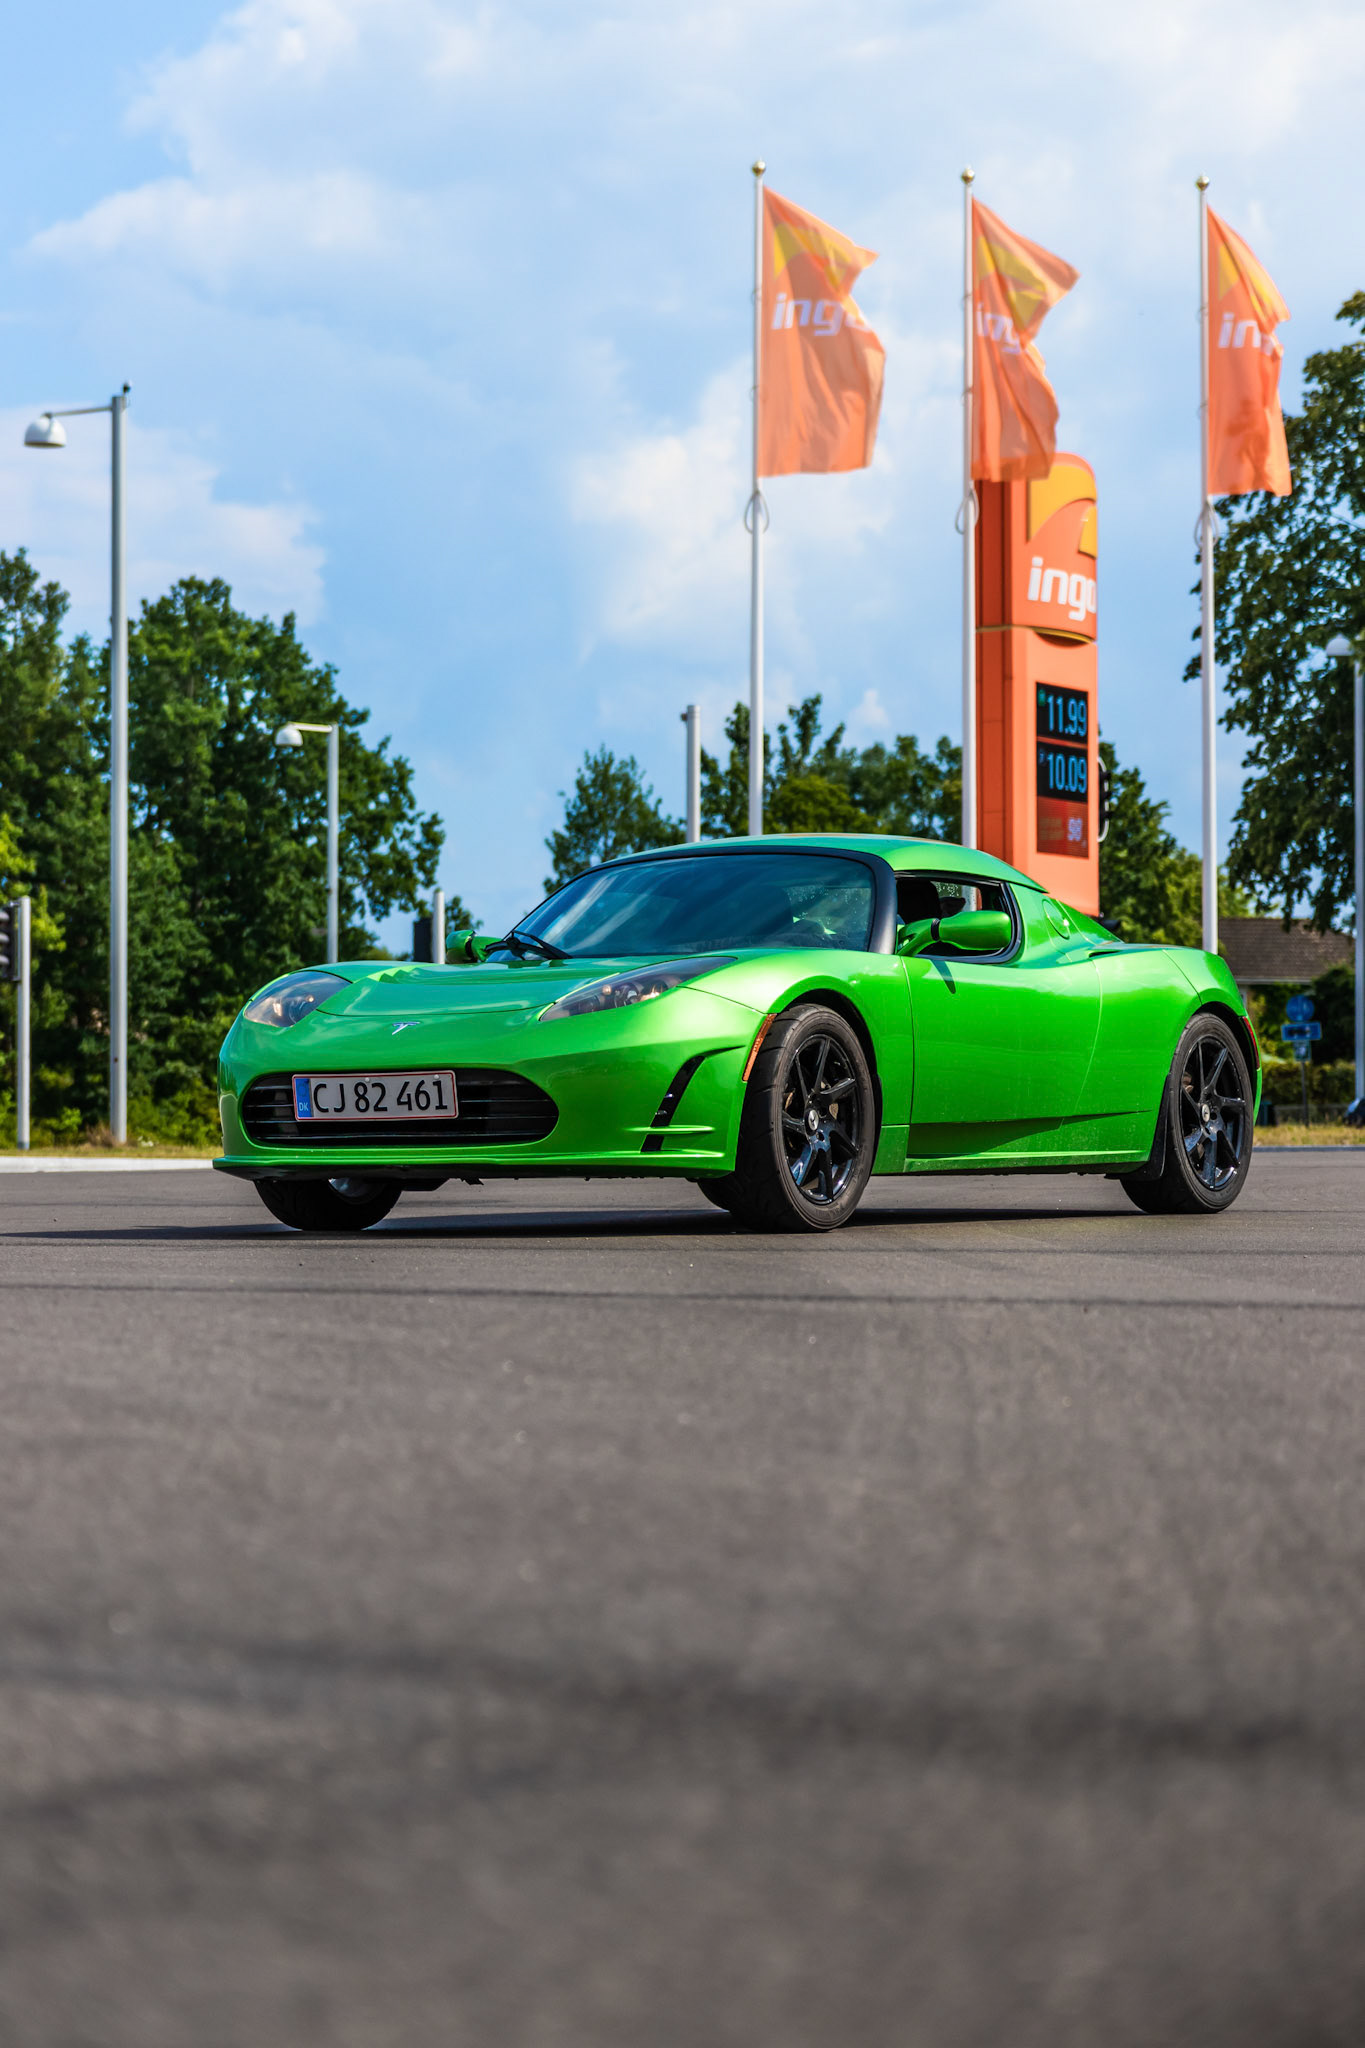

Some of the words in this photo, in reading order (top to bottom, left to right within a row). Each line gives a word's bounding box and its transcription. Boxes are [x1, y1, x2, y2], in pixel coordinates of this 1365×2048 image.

[1218, 312, 1274, 356] in
[1027, 556, 1097, 622] ingo
[1047, 694, 1087, 737] 11.99
[1046, 752, 1087, 794] 10.09
[299, 1102, 309, 1112] DK
[313, 1083, 346, 1113] CJ
[353, 1081, 388, 1113] 82
[396, 1079, 448, 1111] 461
